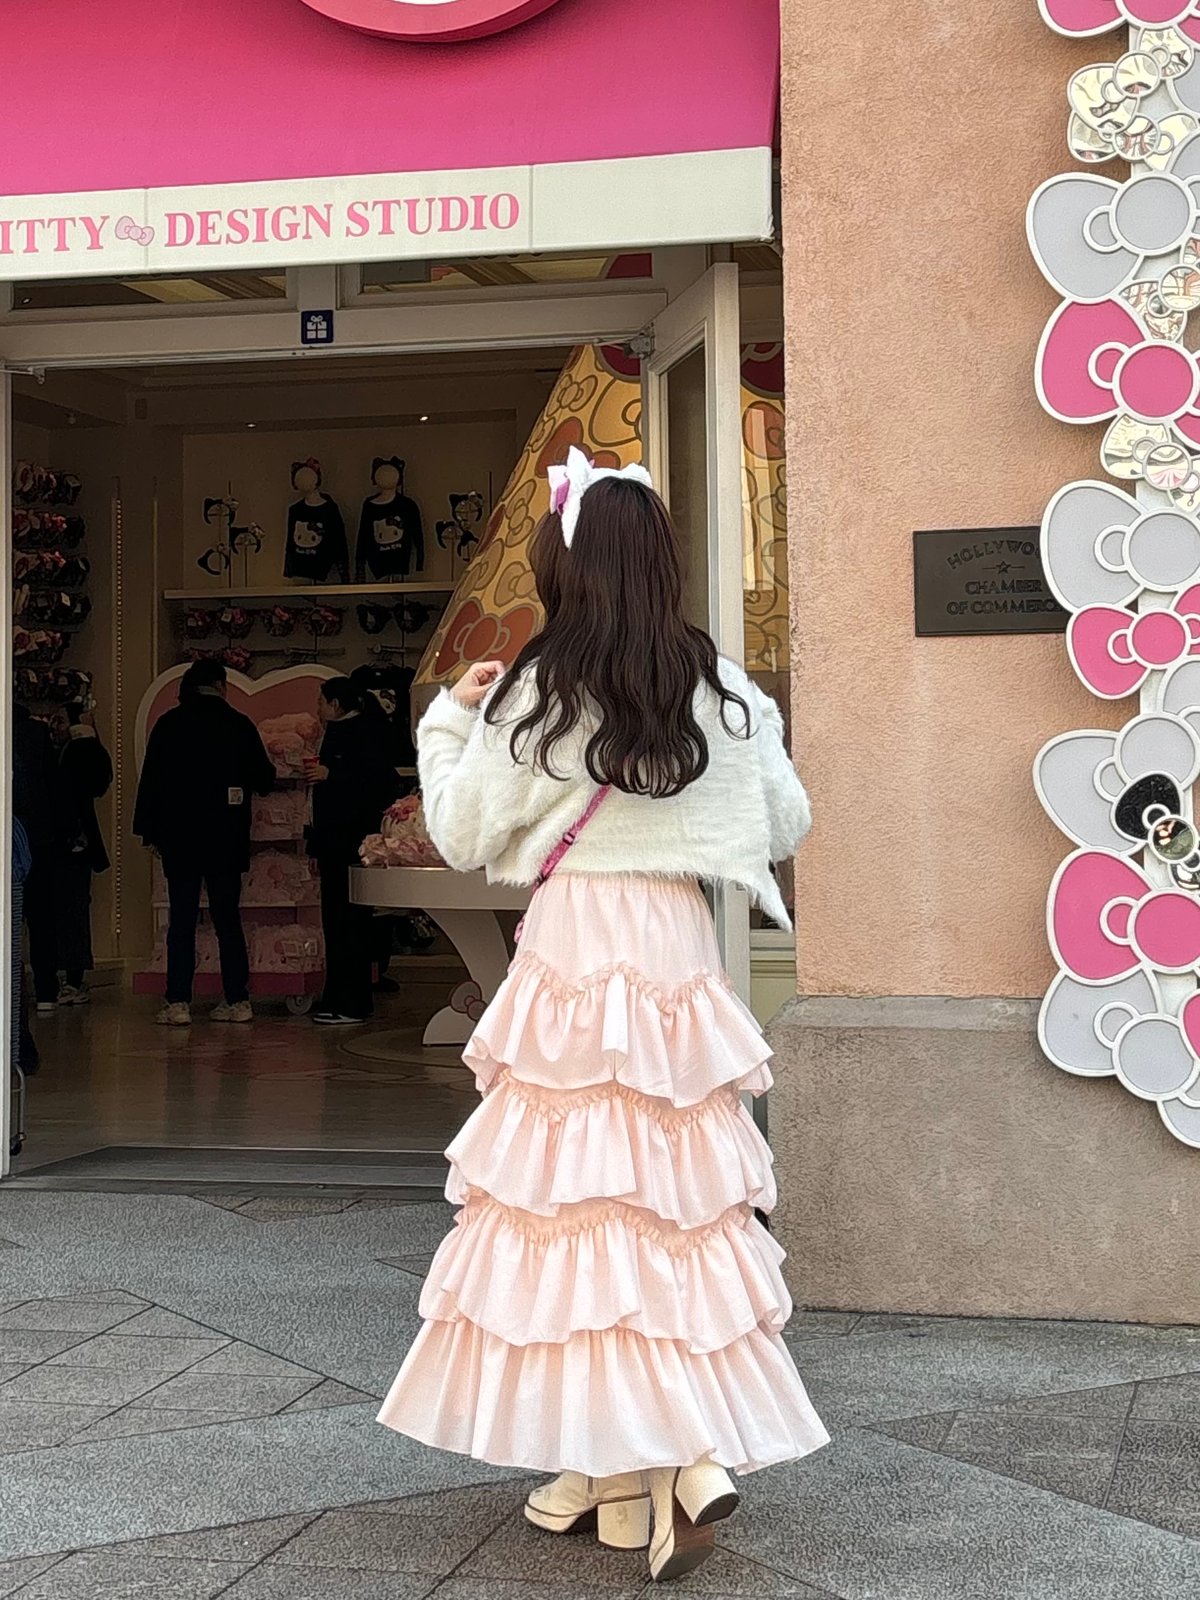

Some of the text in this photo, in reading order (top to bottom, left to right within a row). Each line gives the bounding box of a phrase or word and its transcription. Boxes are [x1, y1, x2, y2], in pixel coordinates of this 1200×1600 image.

[0, 193, 520, 254] ITTY DESIGN STUDIO
[964, 579, 1043, 595] CHAMBER
[946, 601, 969, 615] OF
